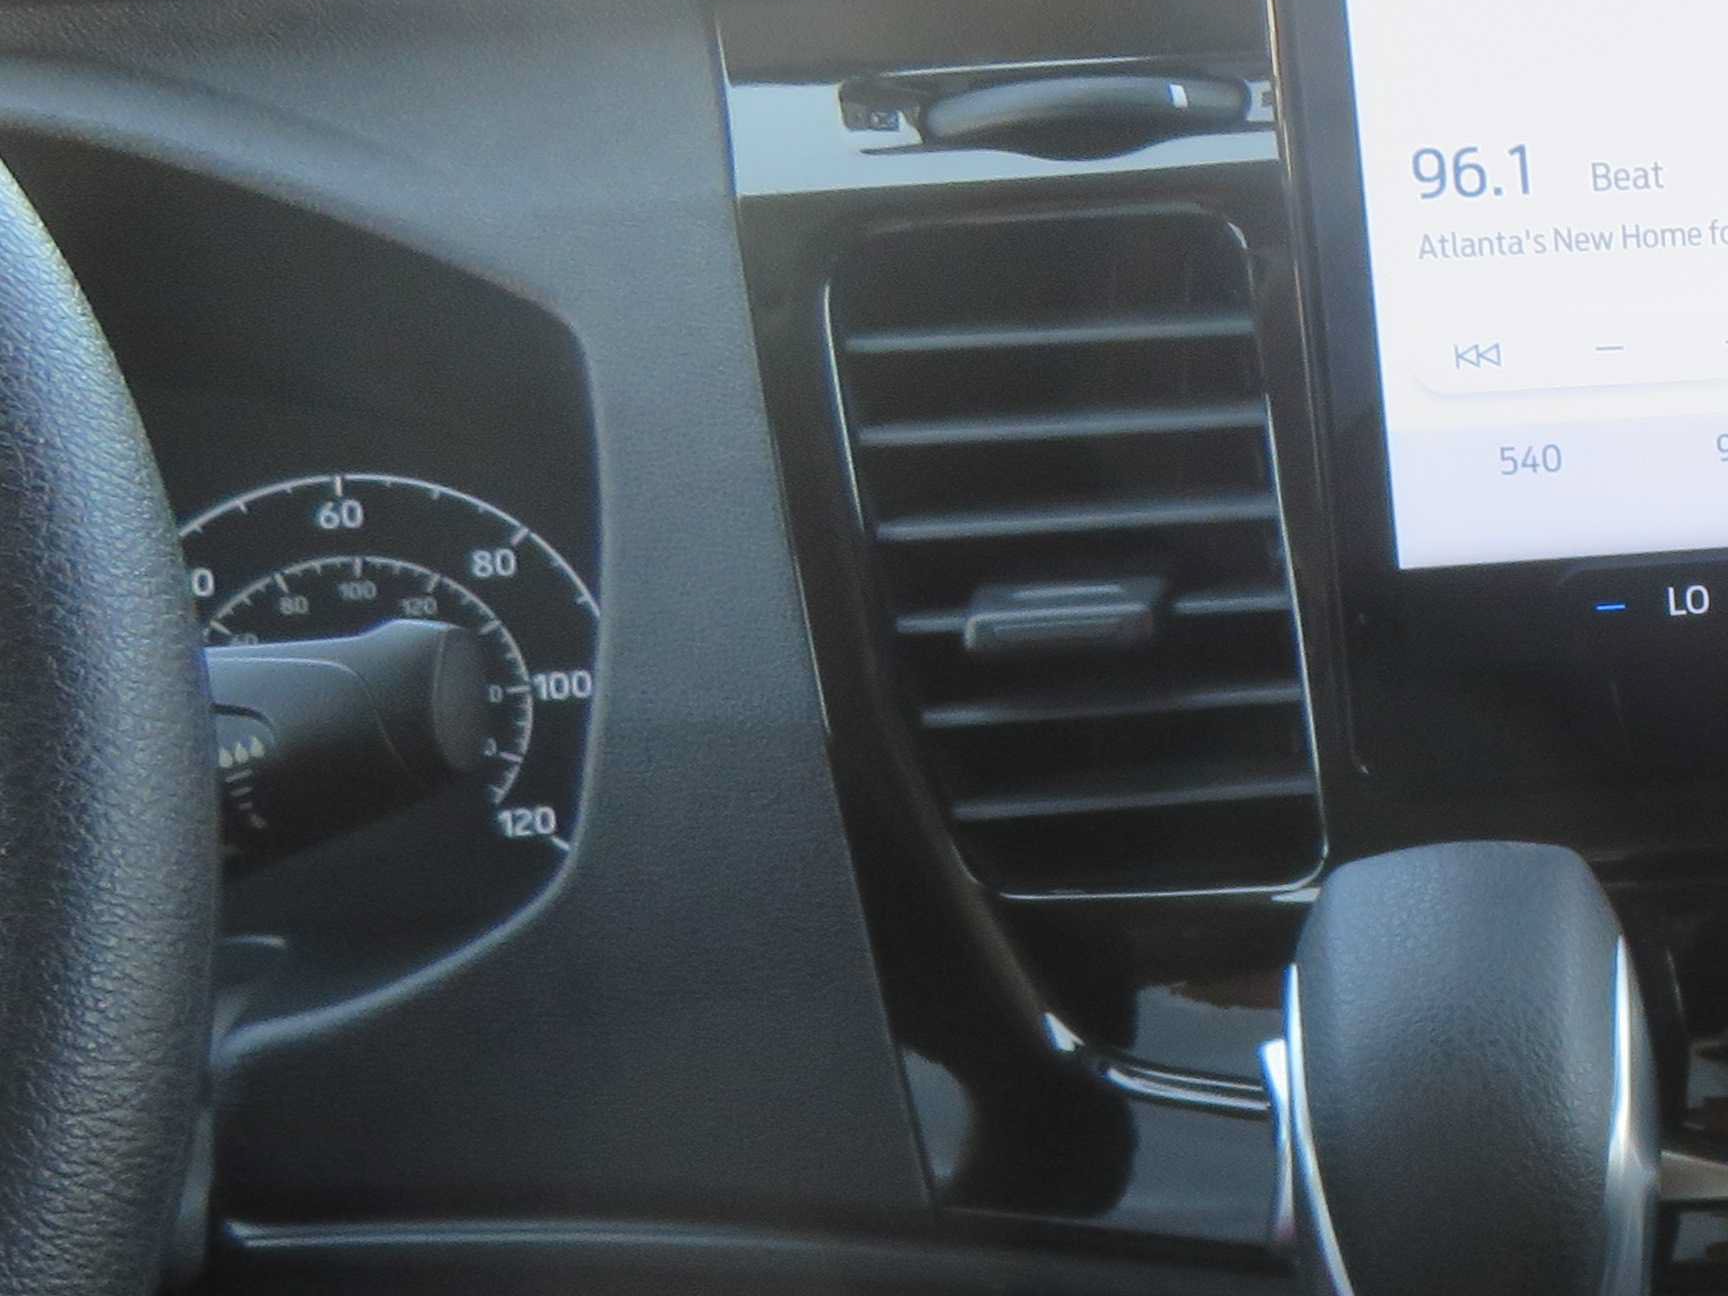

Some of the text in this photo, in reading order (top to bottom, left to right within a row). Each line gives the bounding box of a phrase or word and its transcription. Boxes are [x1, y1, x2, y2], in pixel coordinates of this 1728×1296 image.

[1411, 144, 1666, 201] 96.1 Beat
[1417, 228, 1548, 261] Atlanta's
[1553, 225, 1614, 254] New
[1620, 221, 1703, 250] Home
[1498, 443, 1564, 476] 540
[318, 500, 365, 529] 60
[471, 548, 517, 578] 80
[191, 567, 216, 598] 0
[1667, 584, 1711, 617] LO
[531, 669, 594, 701] 100
[499, 806, 556, 838] 120
